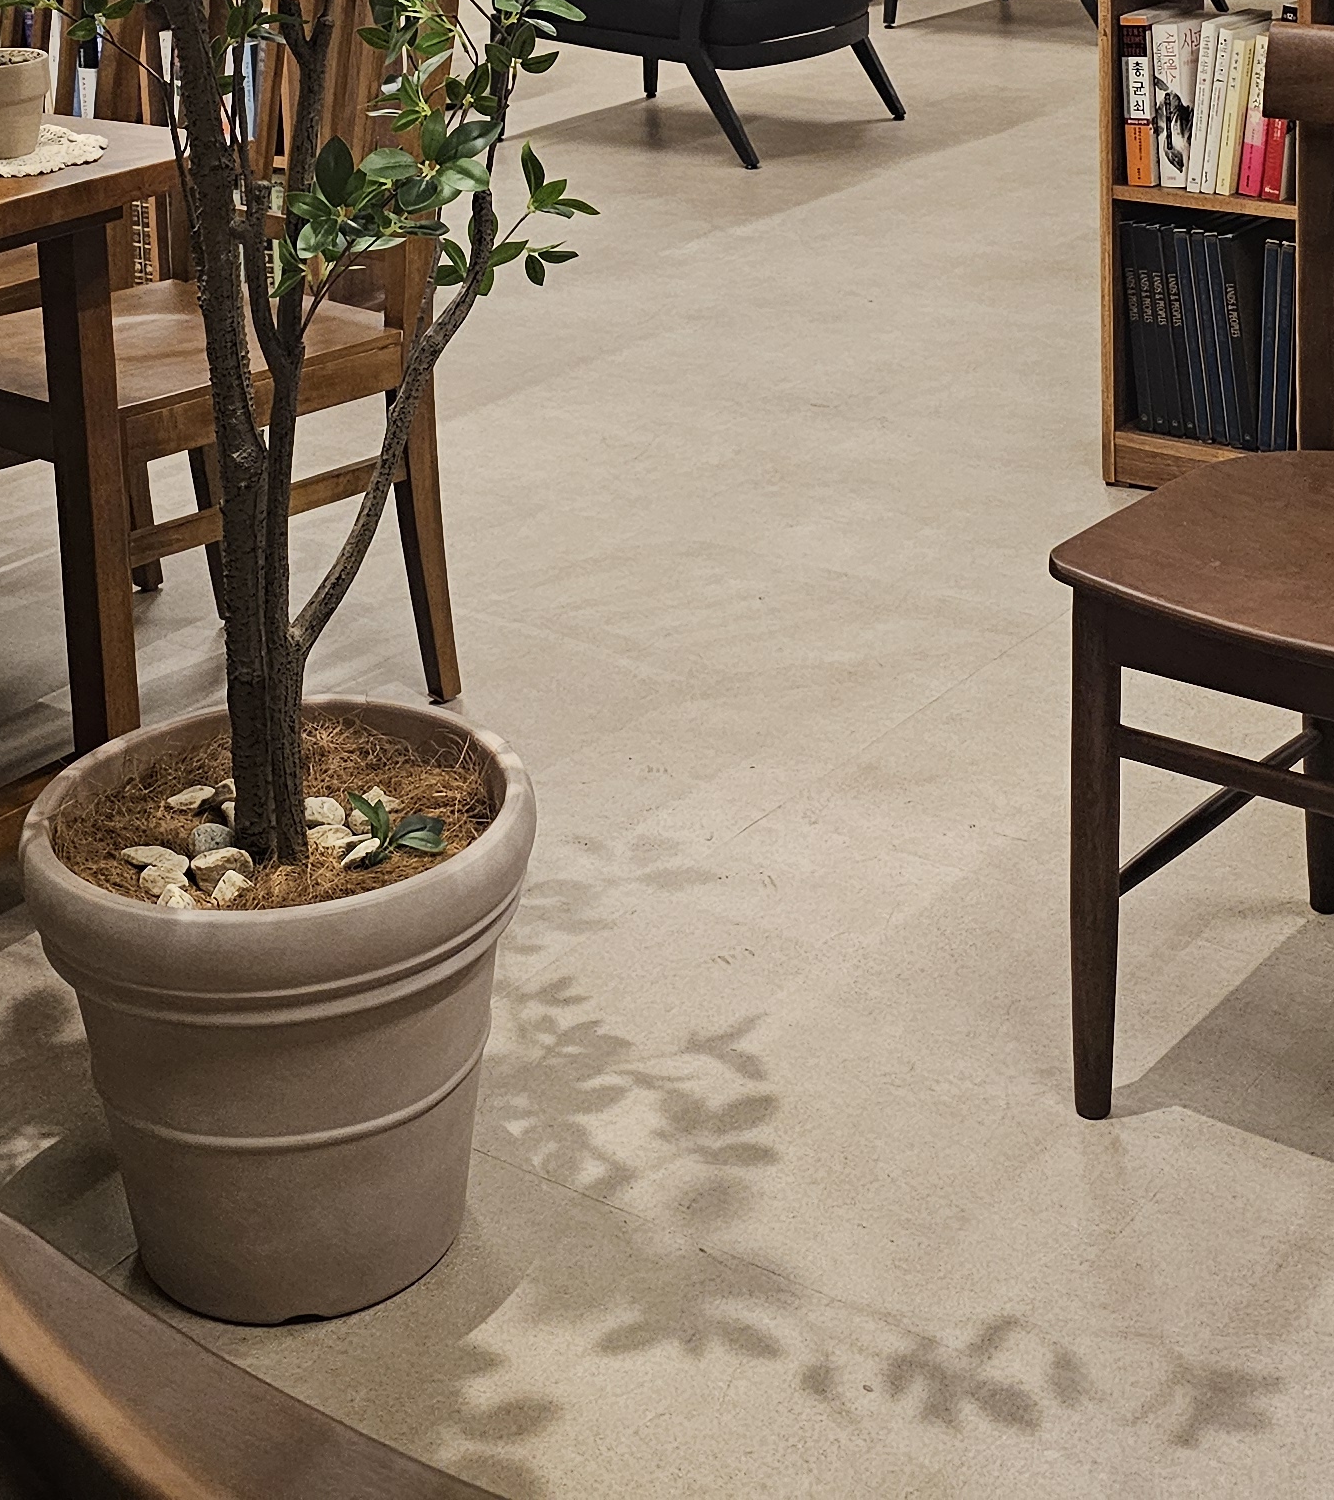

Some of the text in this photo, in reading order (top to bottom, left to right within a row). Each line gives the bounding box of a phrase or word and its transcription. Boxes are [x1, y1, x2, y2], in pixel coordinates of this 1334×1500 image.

[1154, 41, 1163, 75] Sapiens
[1162, 31, 1178, 84] 사피엔스
[1133, 100, 1146, 114] 쇠
